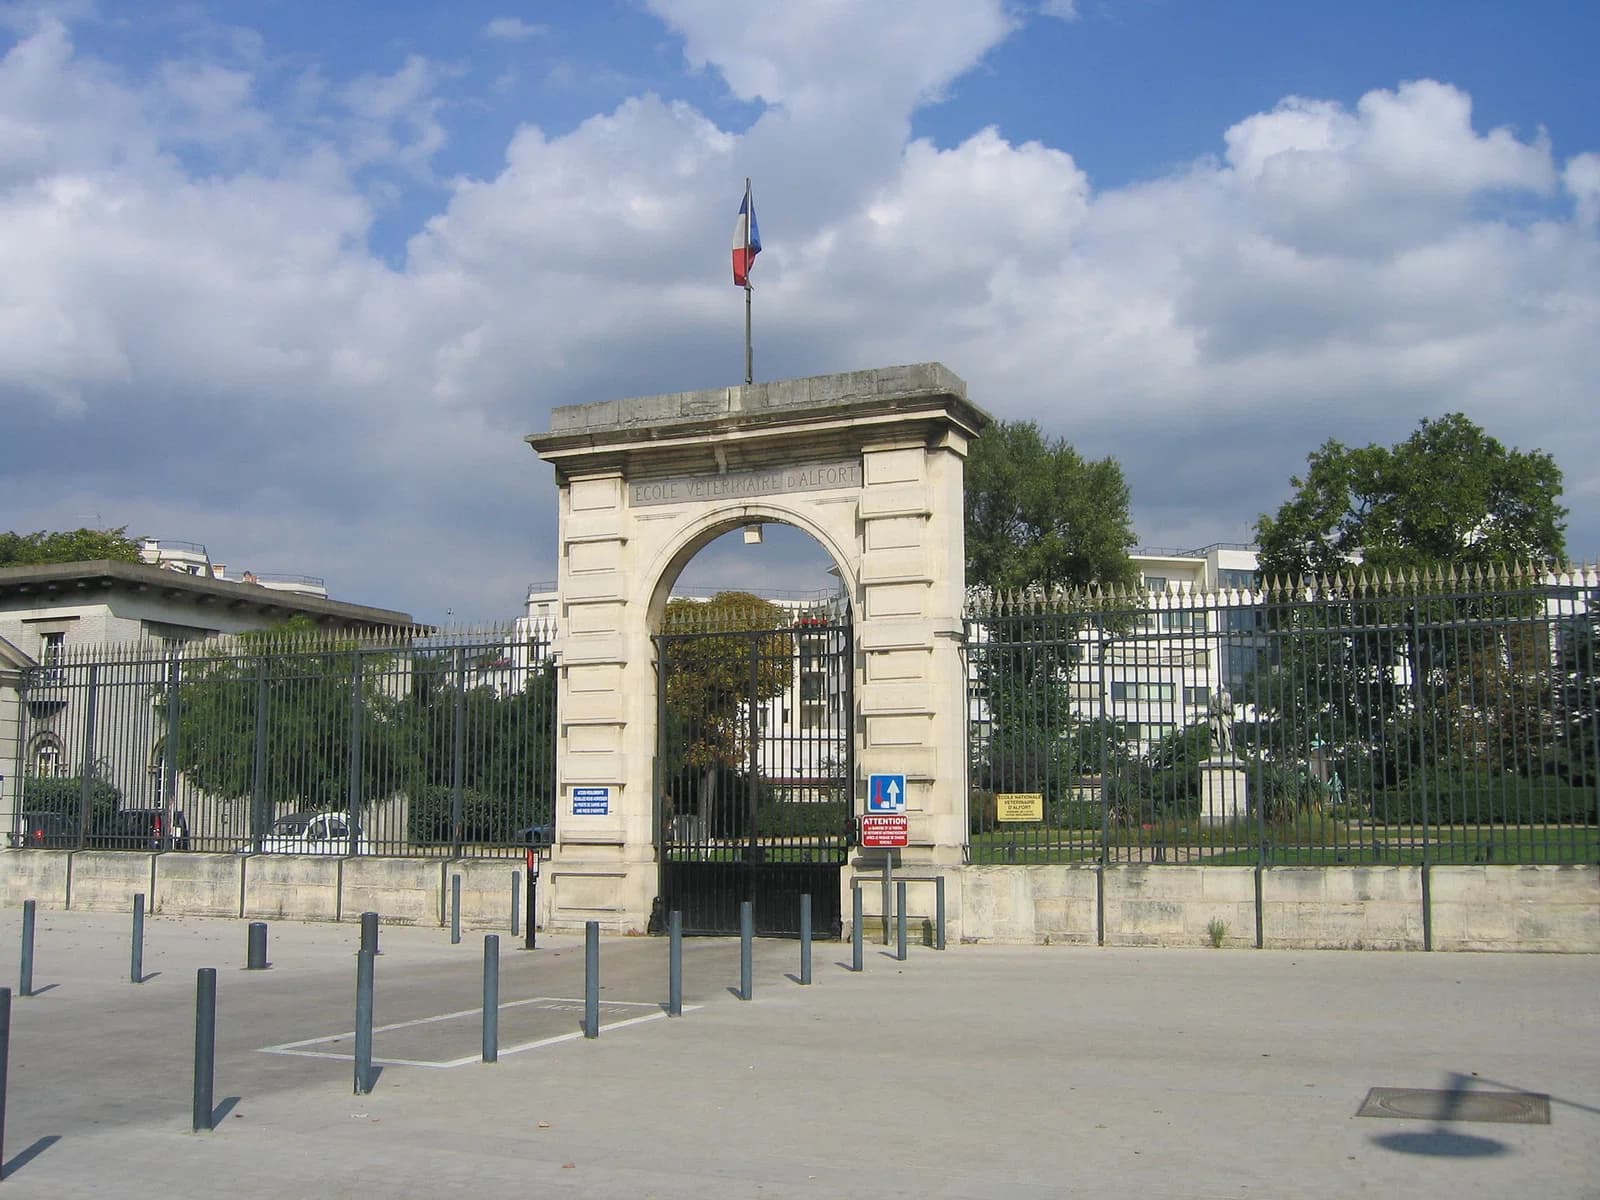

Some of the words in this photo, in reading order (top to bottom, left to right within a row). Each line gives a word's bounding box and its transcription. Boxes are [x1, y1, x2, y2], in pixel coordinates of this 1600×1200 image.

[635, 482, 678, 501] ECOLE
[687, 474, 780, 497] VETERINAIRE
[864, 817, 907, 825] ATTENTION
